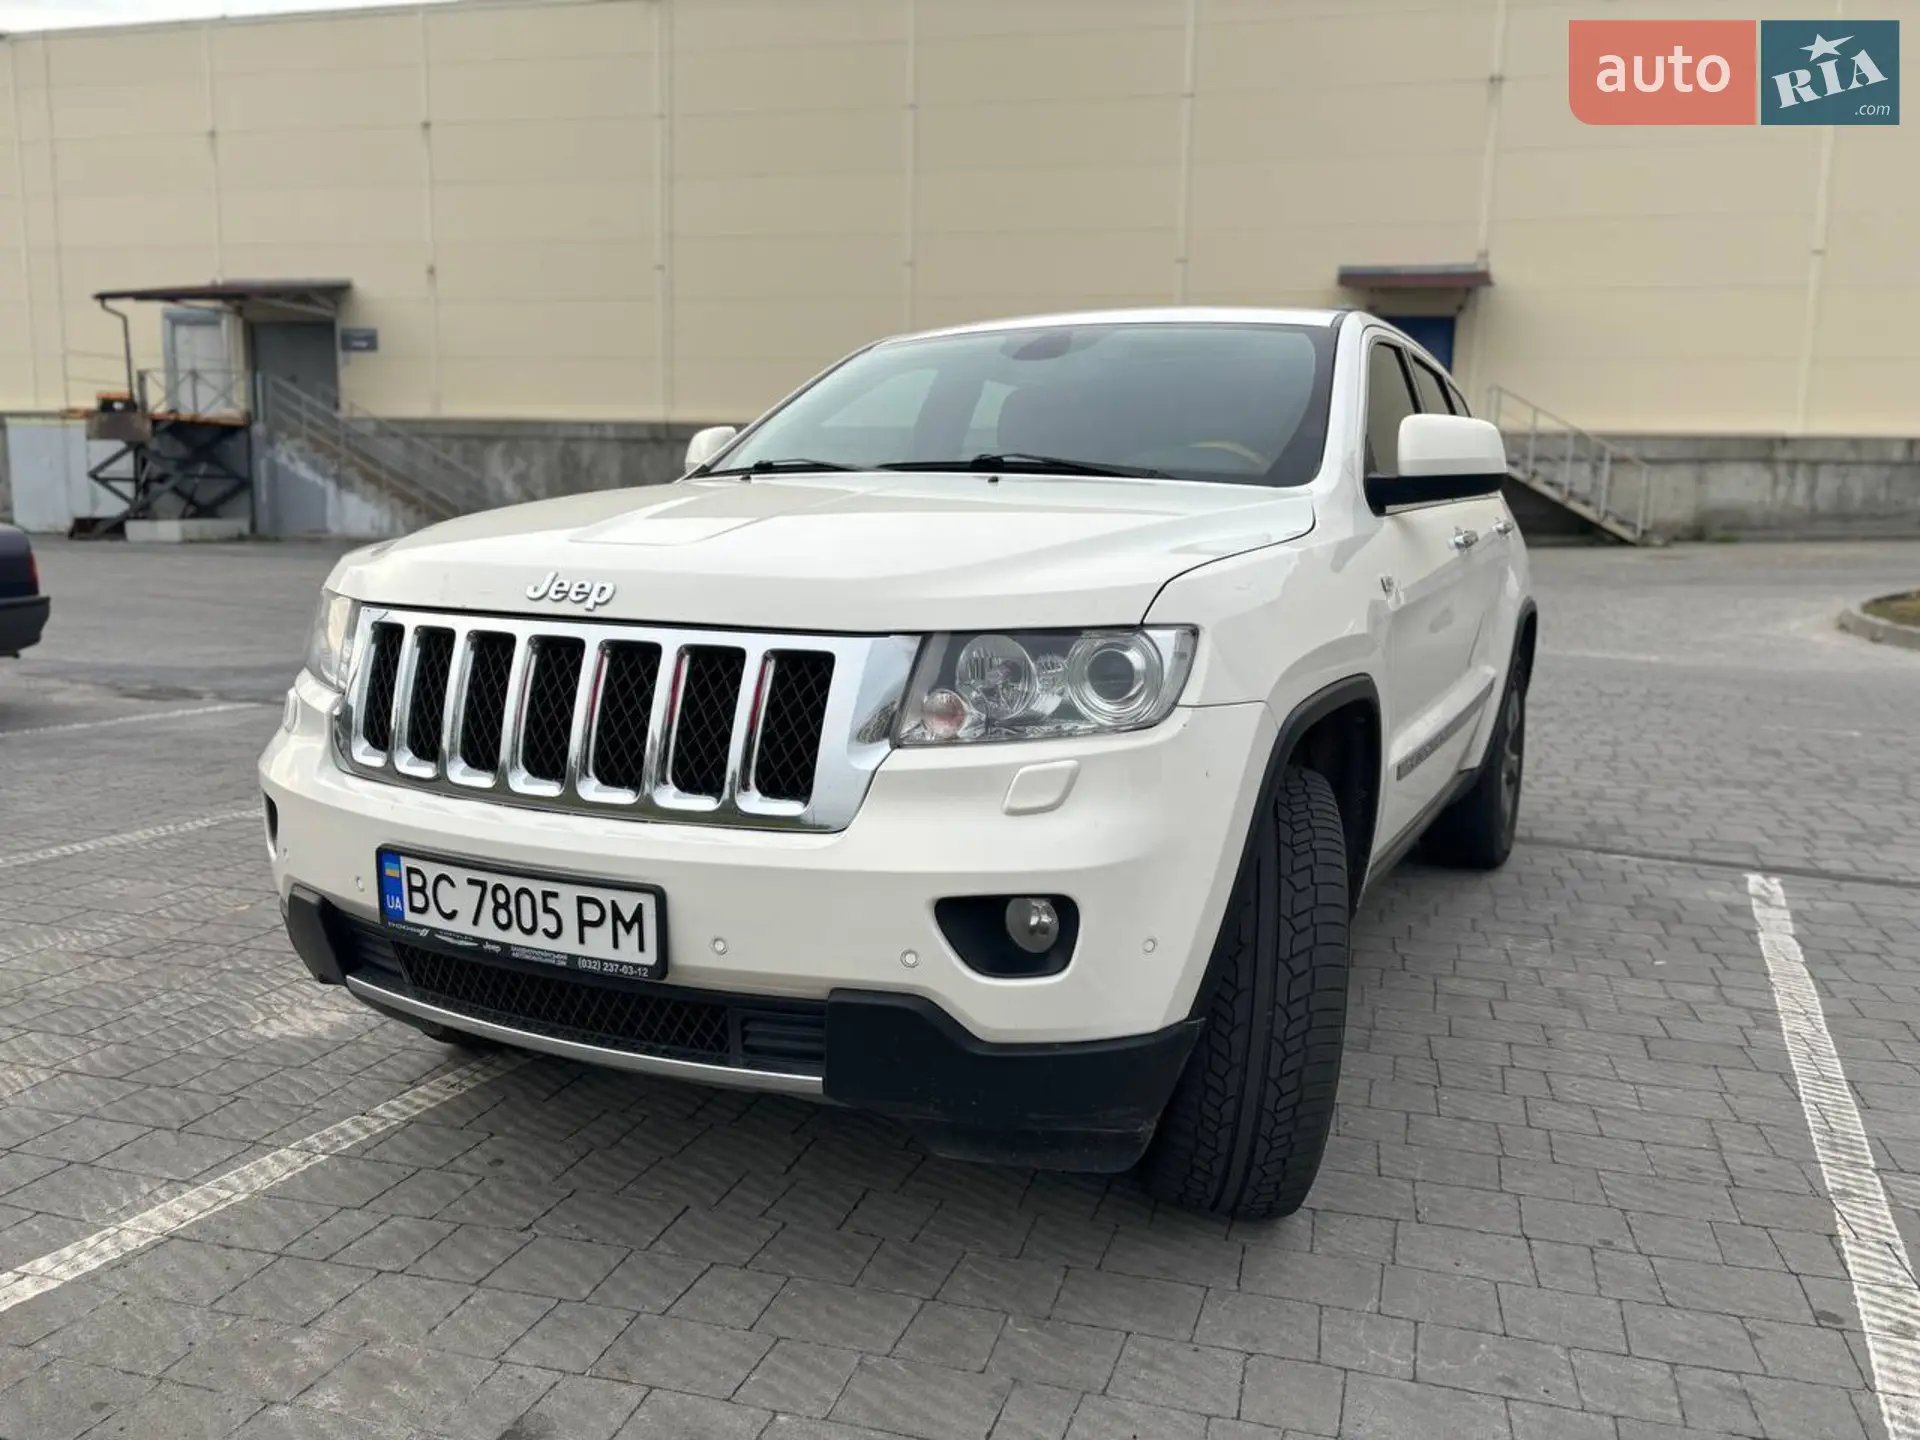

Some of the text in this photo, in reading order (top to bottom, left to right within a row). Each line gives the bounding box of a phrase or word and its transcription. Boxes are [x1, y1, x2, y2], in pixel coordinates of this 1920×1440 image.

[526, 571, 616, 612] Jeep
[386, 894, 402, 911] UA
[406, 866, 645, 953] BC 7805 PM
[578, 957, 601, 971] (032)
[602, 961, 649, 977] 237-03-12
